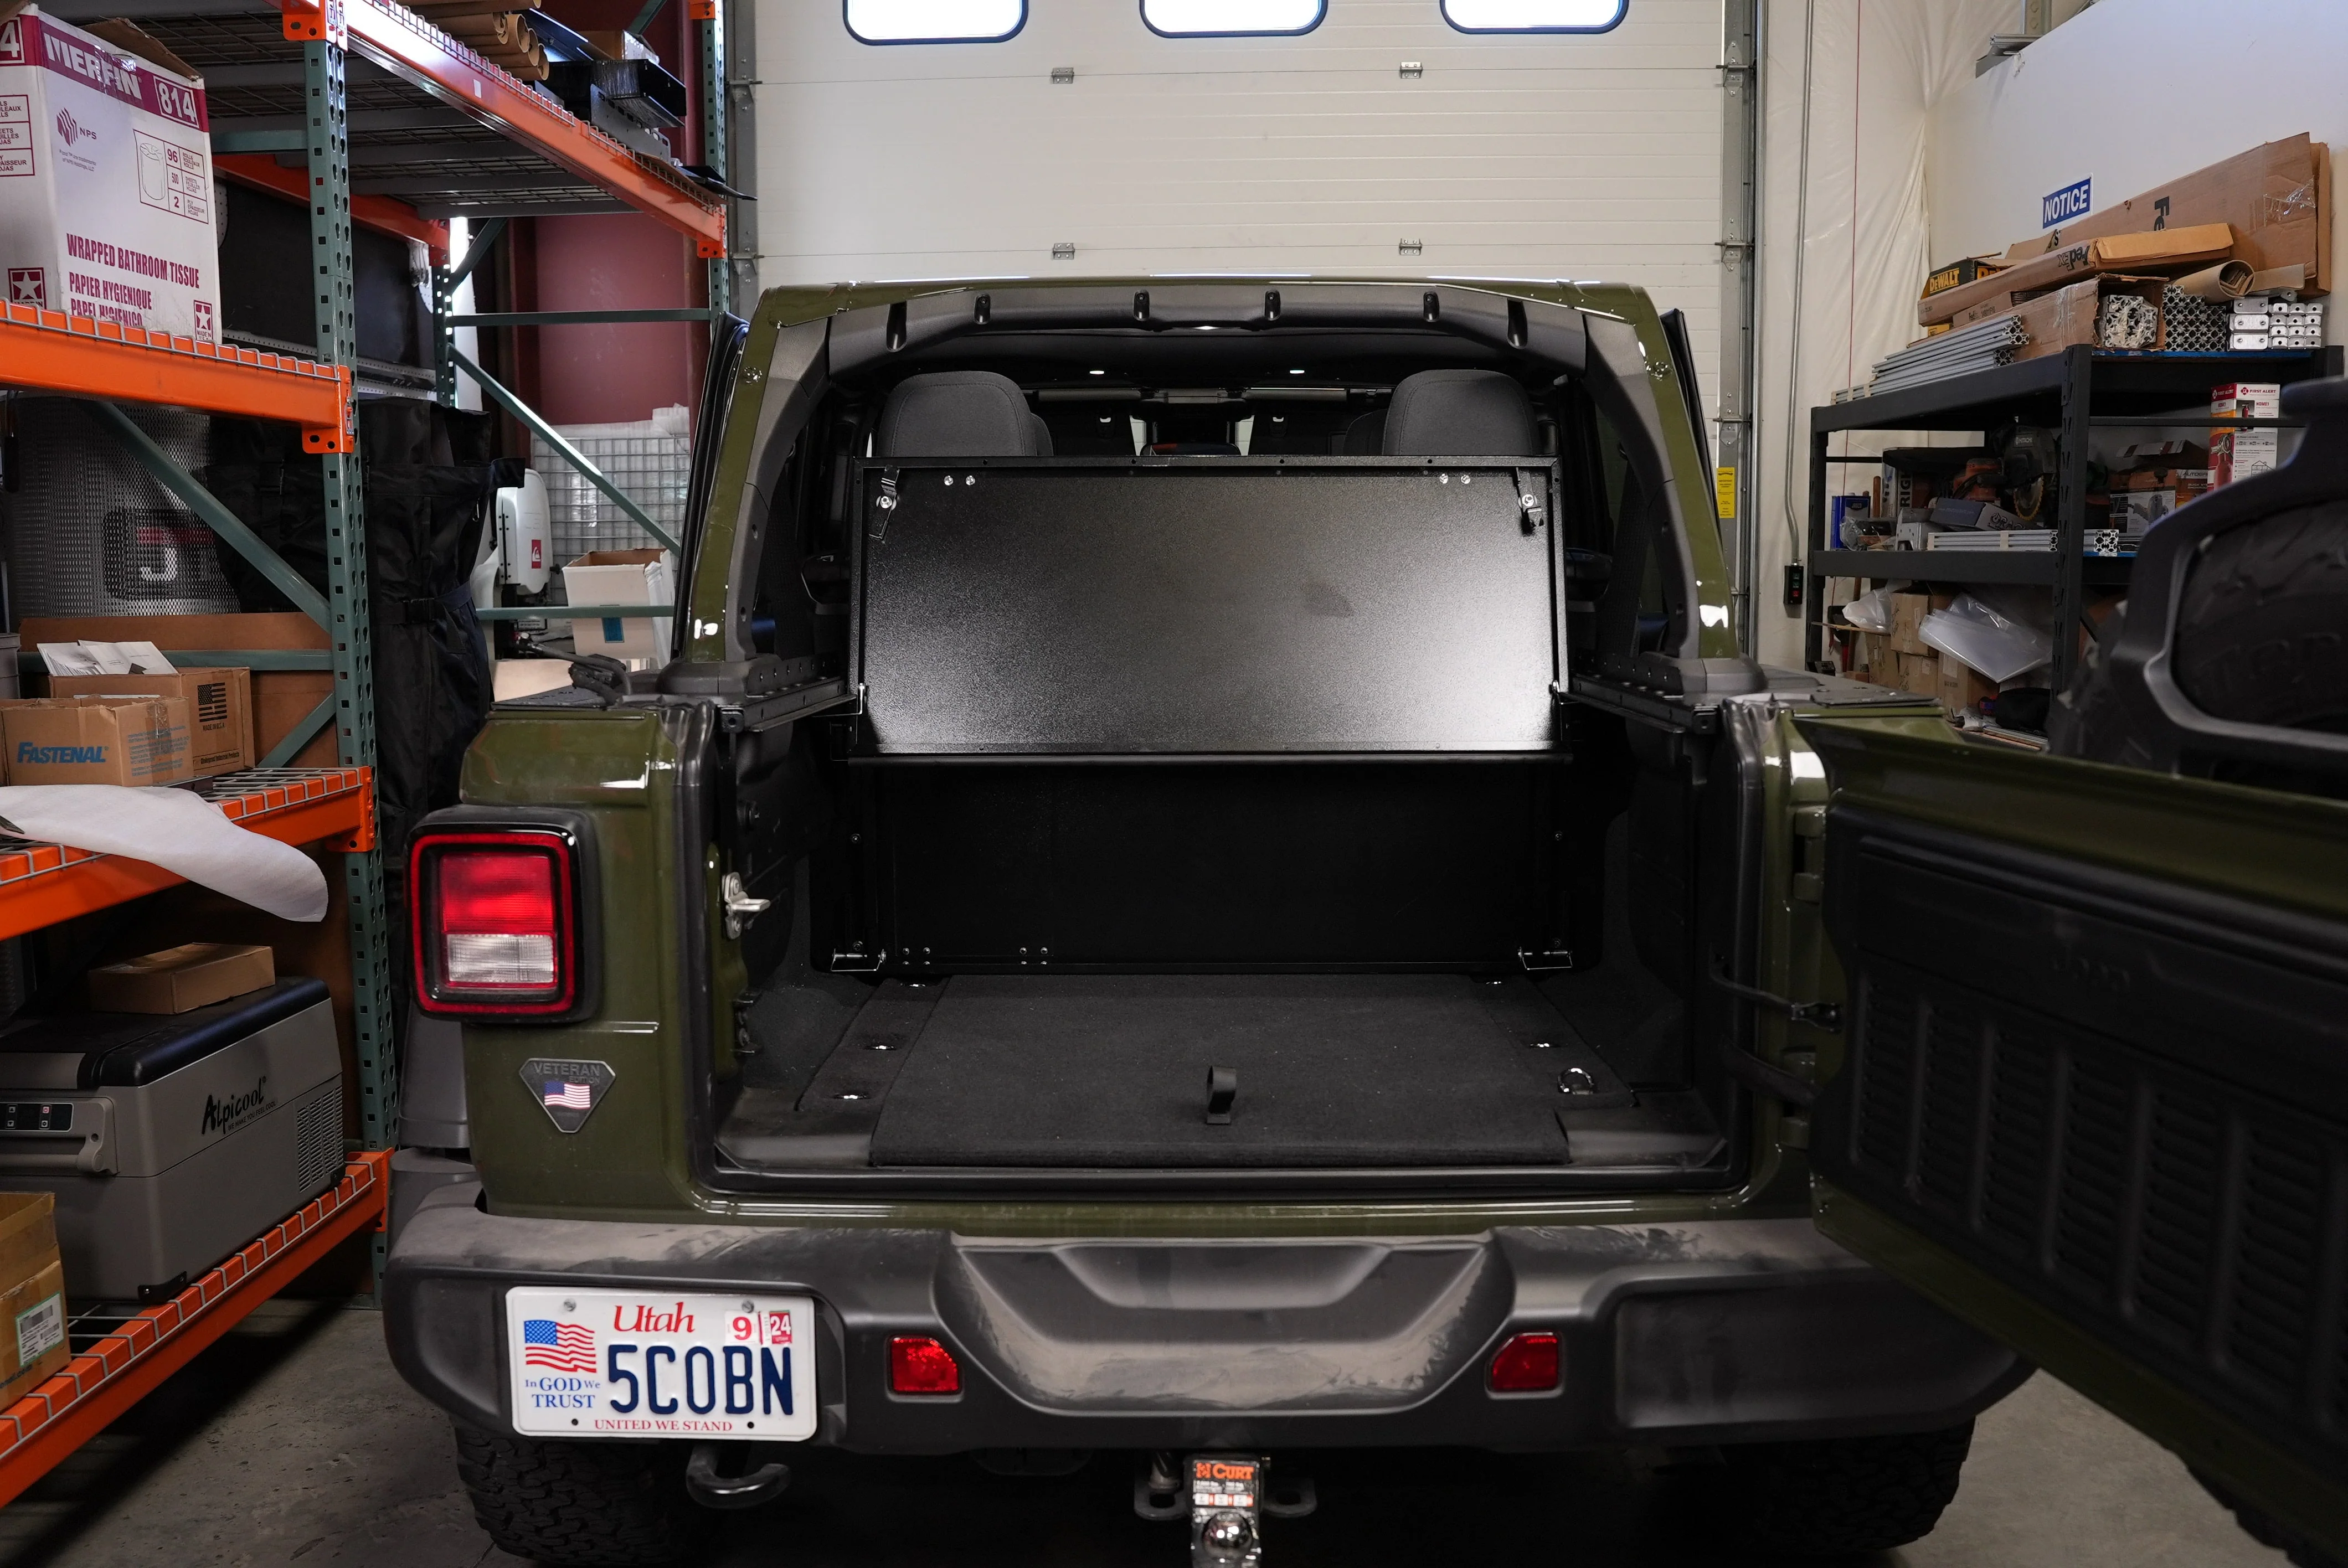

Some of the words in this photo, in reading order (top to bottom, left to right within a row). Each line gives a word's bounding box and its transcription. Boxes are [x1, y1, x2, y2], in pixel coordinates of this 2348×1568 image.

[43, 32, 143, 100] MERFIN
[158, 82, 195, 123] 814
[80, 127, 97, 140] NPS
[167, 148, 178, 163] 96
[174, 196, 179, 209] 2
[2044, 184, 2089, 224] NOTICE
[66, 233, 116, 267] WRAPPED
[117, 247, 168, 281] BATHROOM
[169, 261, 200, 289] TISSUE
[69, 271, 101, 298] PAPIER
[102, 280, 152, 311] HYGIENIQUE
[533, 1062, 600, 1076] VETERAN
[569, 1076, 600, 1084] EDITION
[201, 1077, 264, 1135] Alpicool
[256, 1108, 265, 1116] FEEL
[614, 1302, 696, 1333] Utah
[770, 1314, 792, 1337] 24
[733, 1316, 752, 1340] 9
[524, 1379, 537, 1388] In
[539, 1377, 582, 1391] GOD
[584, 1380, 601, 1389] We
[532, 1394, 596, 1408] TRUST
[594, 1419, 651, 1430] UNITED
[655, 1420, 679, 1431] WE
[683, 1421, 733, 1432] STAND
[1212, 1463, 1254, 1480] CURT
